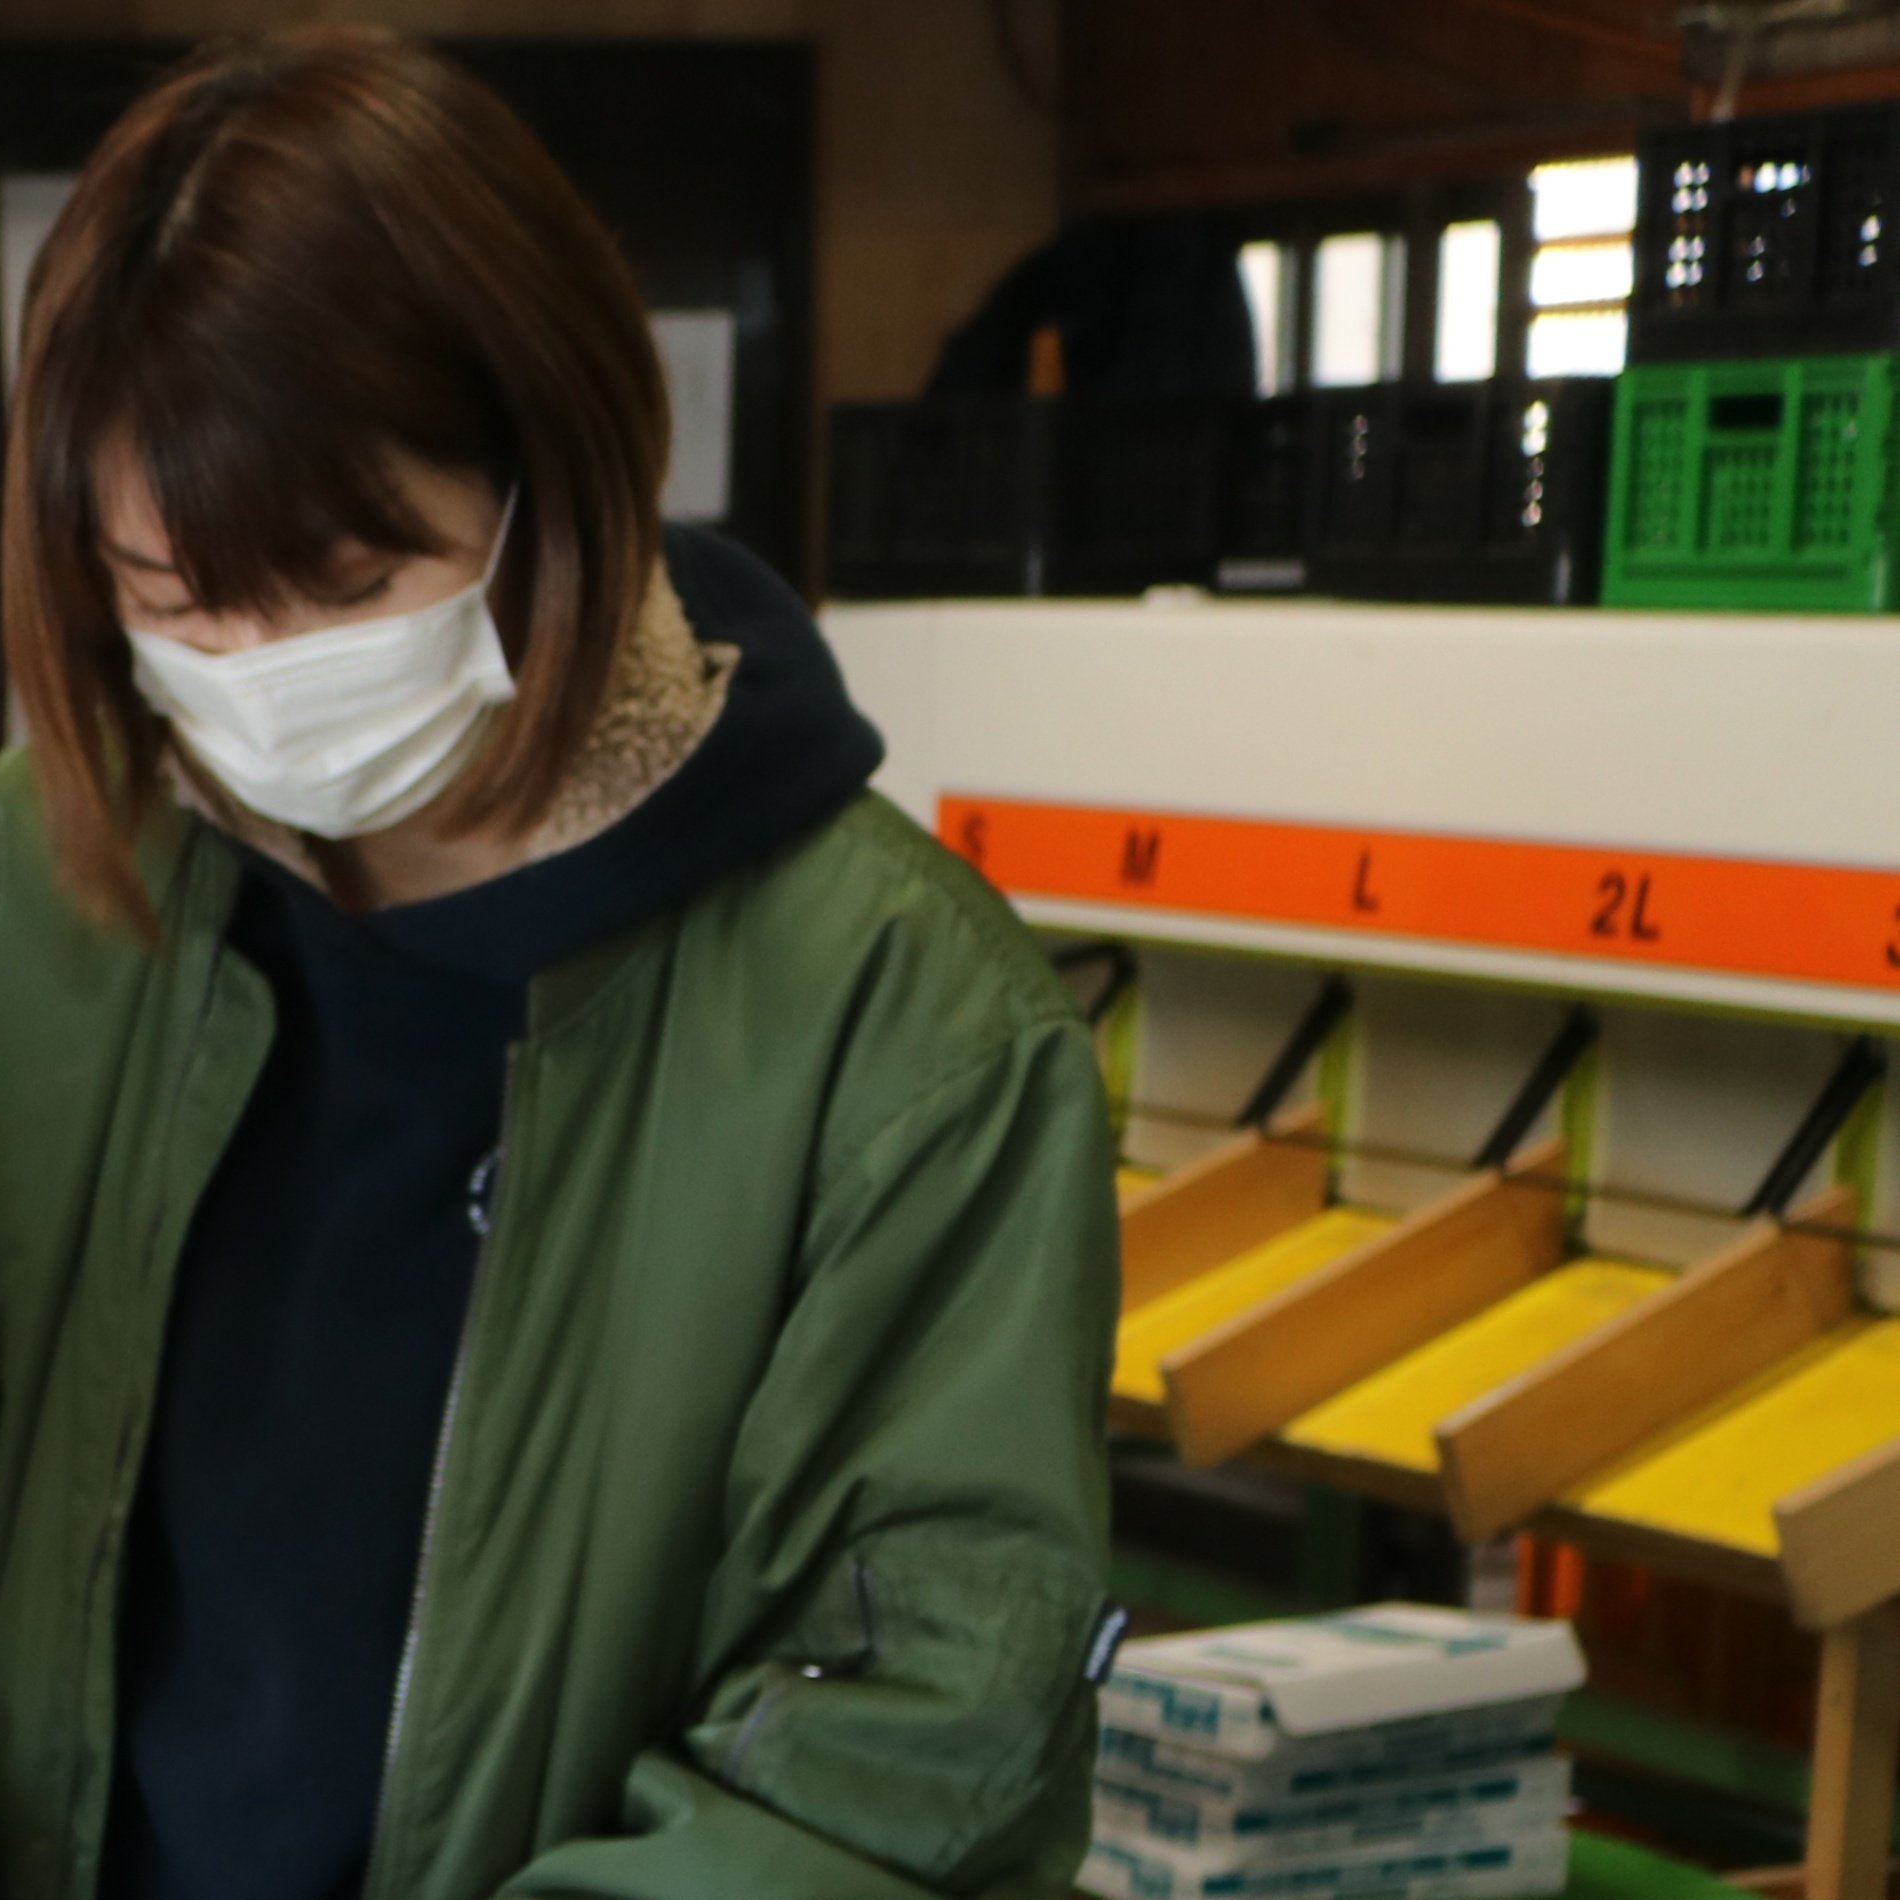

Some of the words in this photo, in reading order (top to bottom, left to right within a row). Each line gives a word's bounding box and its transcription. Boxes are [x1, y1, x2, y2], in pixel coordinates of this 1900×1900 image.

[1122, 829, 1160, 886] M
[1353, 849, 1380, 912] L
[1589, 874, 1660, 942] 2L
